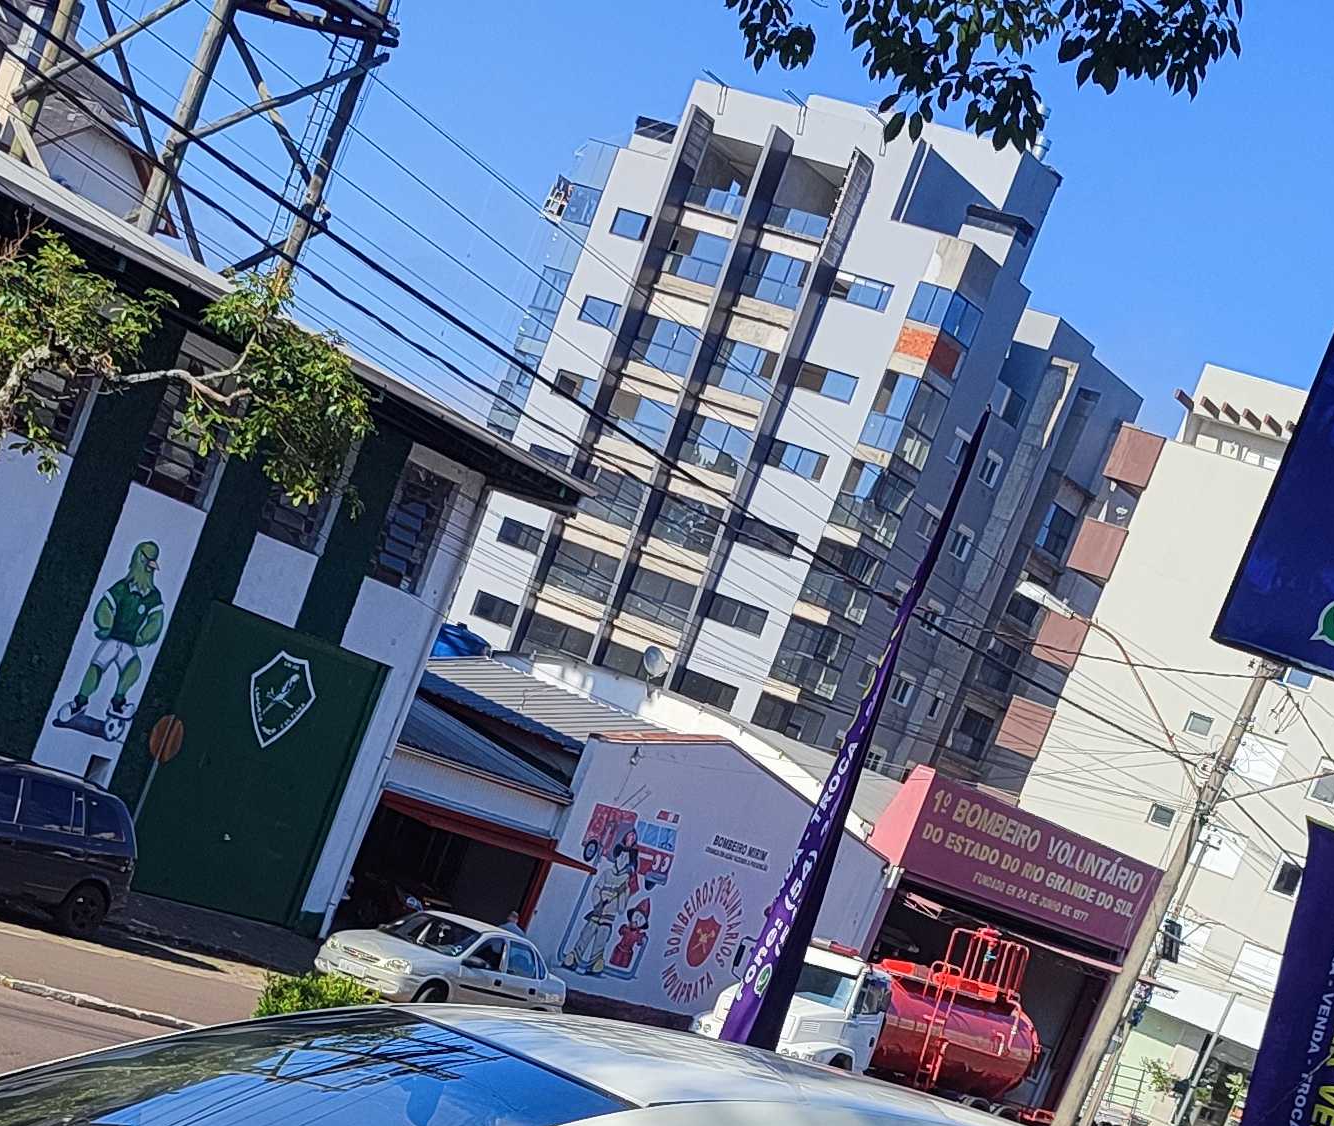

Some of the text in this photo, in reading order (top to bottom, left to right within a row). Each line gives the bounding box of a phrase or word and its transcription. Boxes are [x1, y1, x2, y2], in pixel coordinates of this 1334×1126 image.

[810, 742, 859, 826] TROCA
[712, 834, 748, 856] BOMBEIRO
[922, 823, 1135, 919] DO ESTADO DO RIO GRANDE DO SUL
[952, 799, 1041, 852] BOMBEIRO
[1046, 836, 1144, 895] VOLUNTÁRIO
[663, 878, 716, 958] BOMBEIROS
